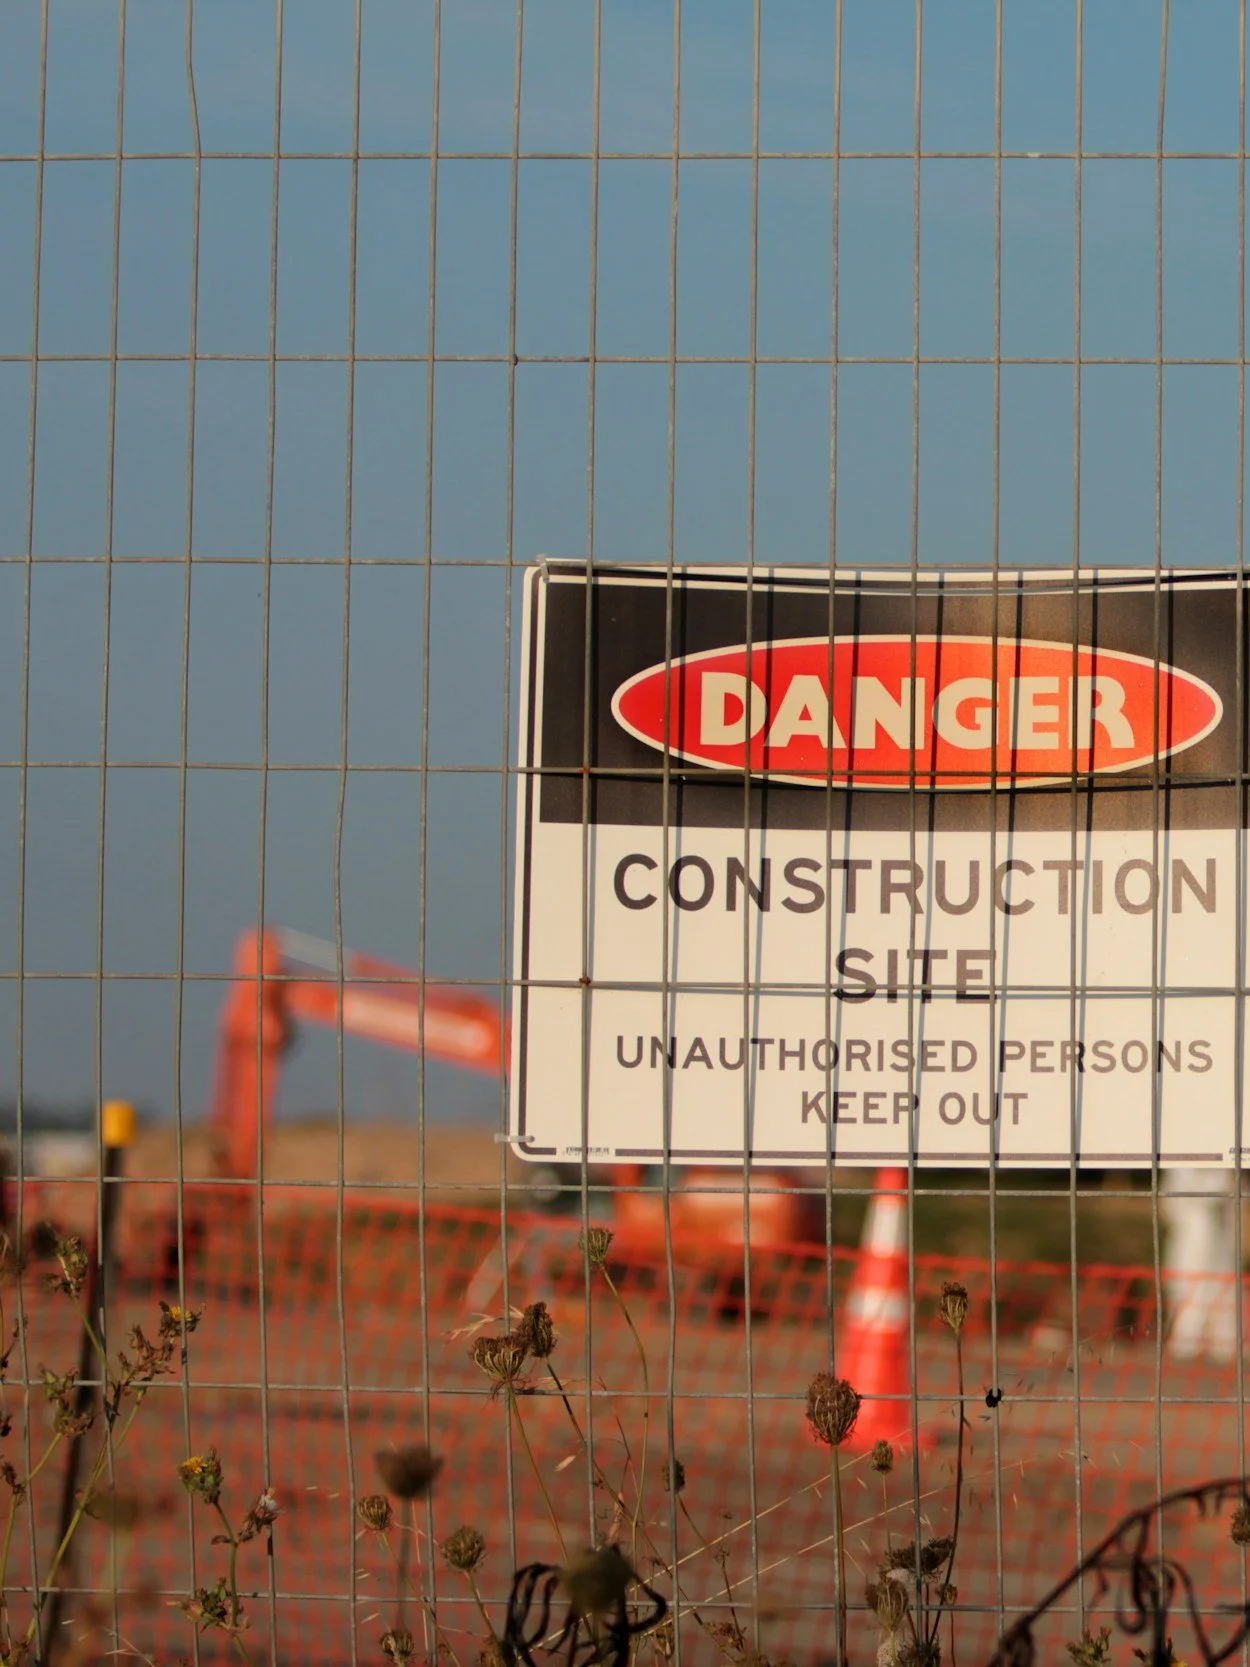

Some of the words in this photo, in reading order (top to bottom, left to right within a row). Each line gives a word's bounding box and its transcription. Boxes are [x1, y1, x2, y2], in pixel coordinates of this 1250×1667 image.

[700, 672, 1135, 750] DANGER
[613, 854, 1217, 914] CONSTRUCTION
[834, 948, 998, 1004] SITE
[616, 1036, 977, 1073] UNAUTHORISED
[1000, 1040, 1213, 1073] PERSONS
[801, 1092, 920, 1124] KEEP
[938, 1092, 1028, 1125] OUT
